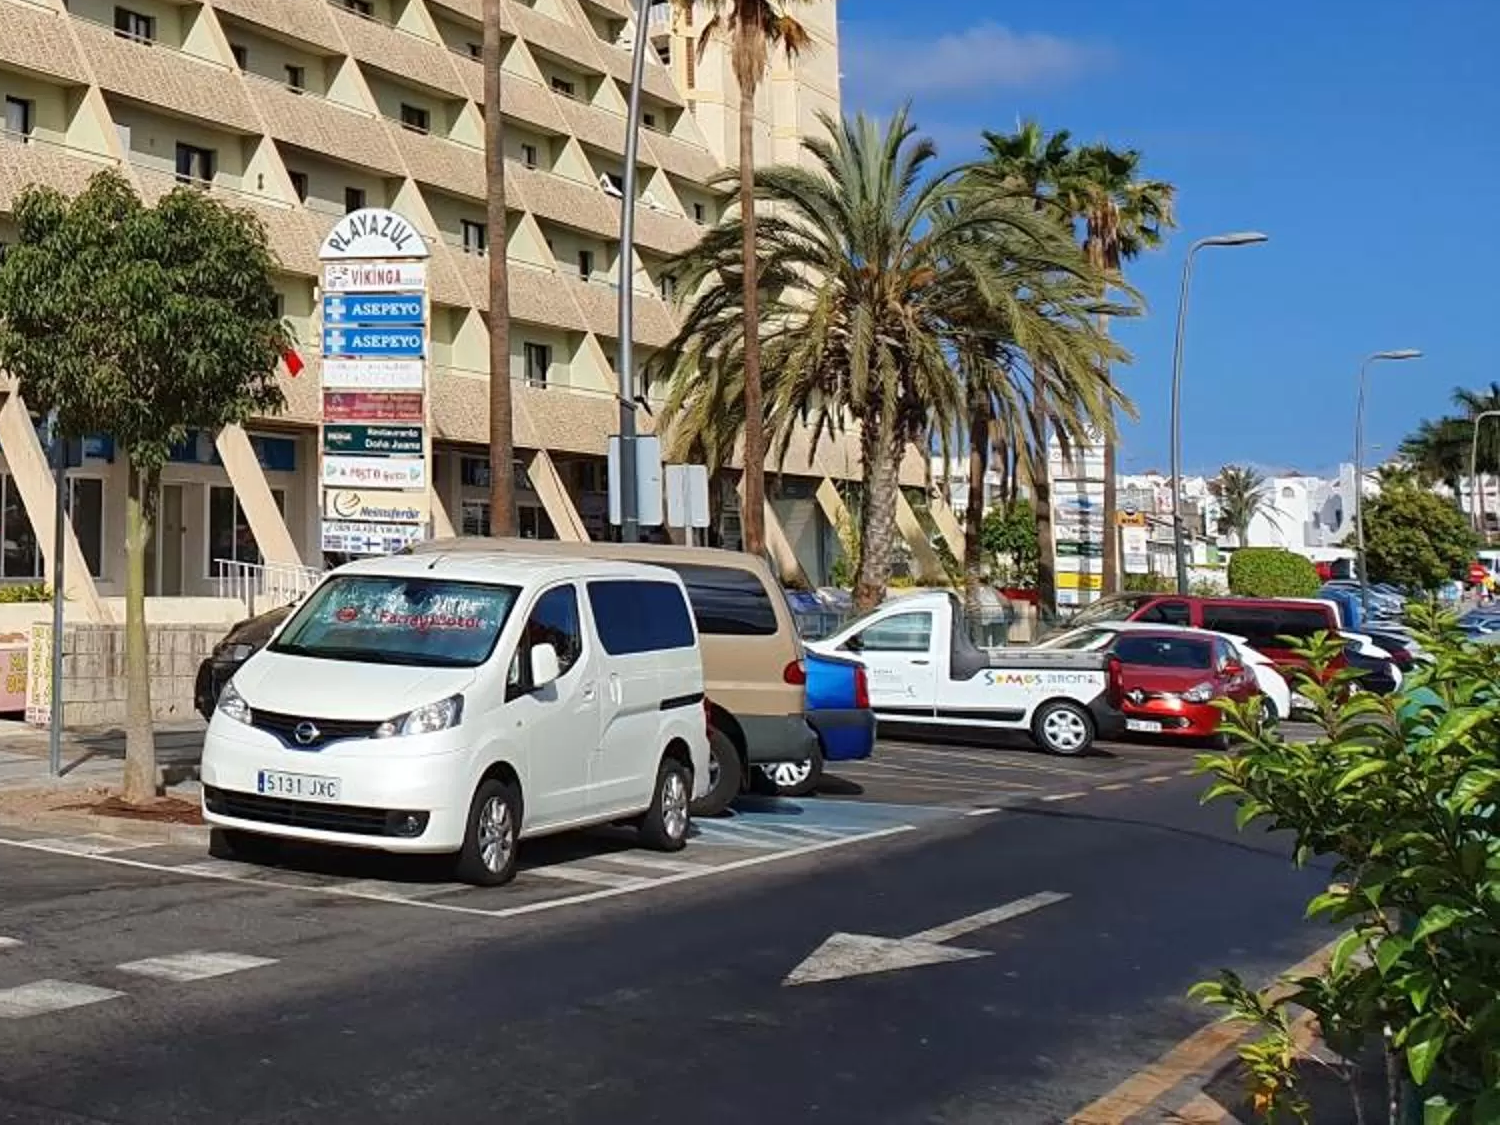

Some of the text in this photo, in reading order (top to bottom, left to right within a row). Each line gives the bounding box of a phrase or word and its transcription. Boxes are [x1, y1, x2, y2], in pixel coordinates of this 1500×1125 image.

[328, 213, 413, 252] PLAYAZUL
[351, 302, 420, 316] ASEPEYO
[351, 334, 420, 348] ASEPEYO
[267, 775, 336, 798] 5131 JXC
